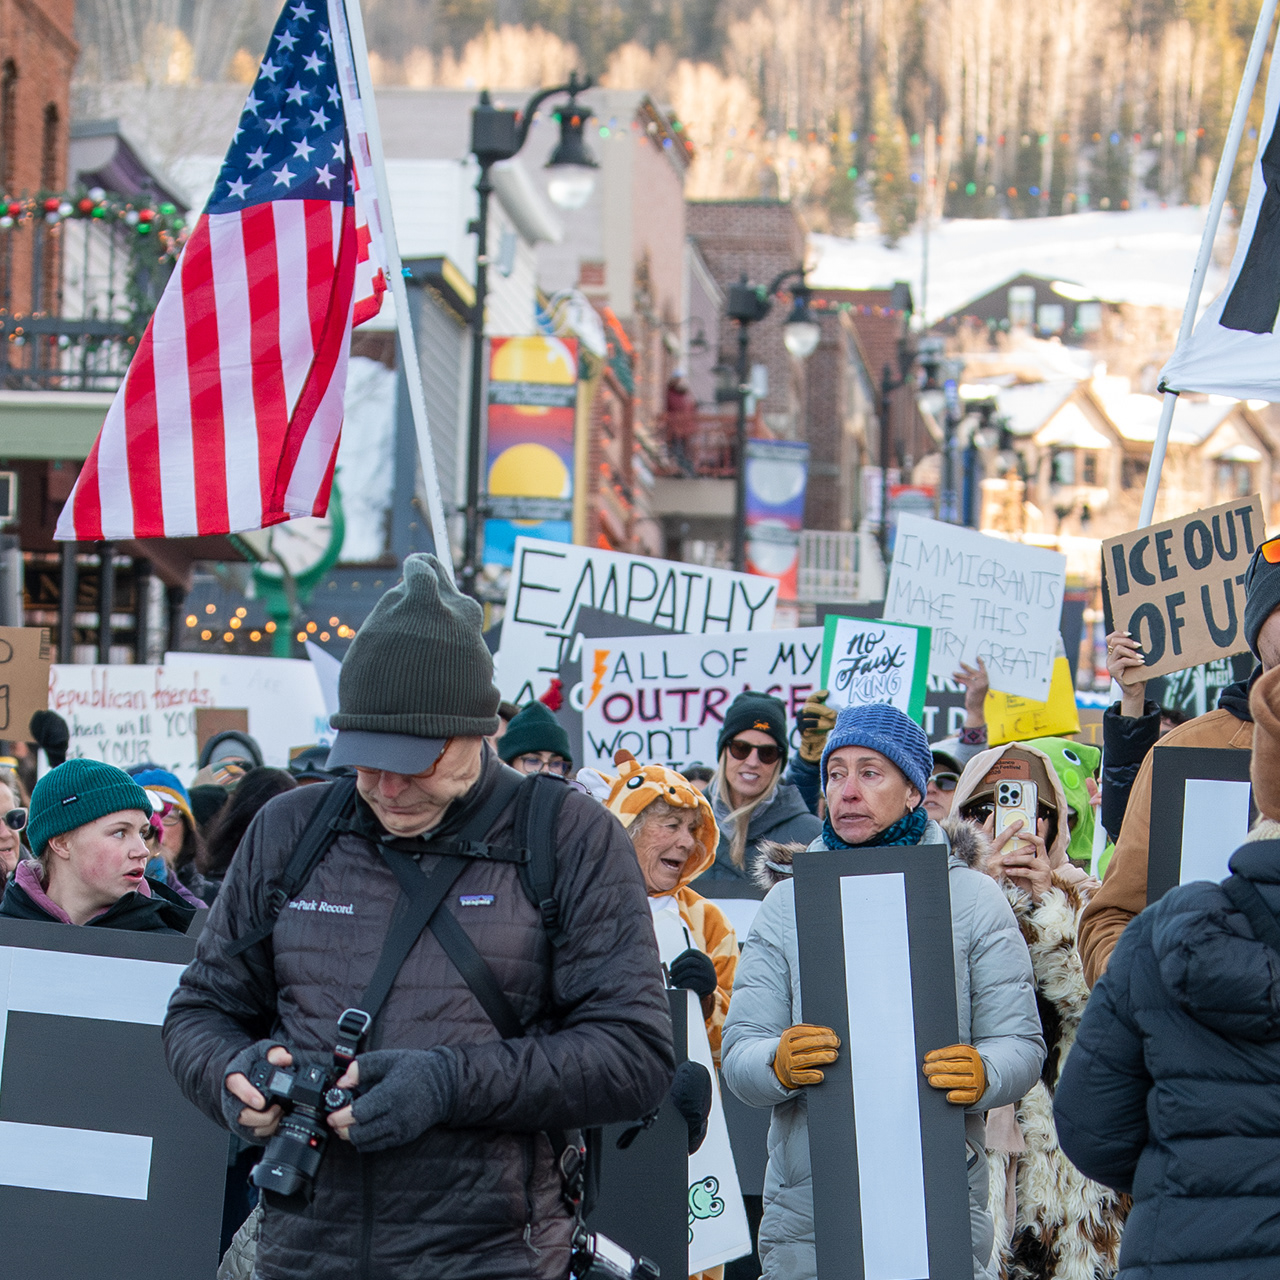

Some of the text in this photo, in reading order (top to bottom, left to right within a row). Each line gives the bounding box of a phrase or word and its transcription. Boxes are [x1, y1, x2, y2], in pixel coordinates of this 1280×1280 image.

[896, 533, 1061, 610] IMMIGRANTS
[1111, 505, 1255, 597] ICE OUT
[513, 547, 776, 634] EMPATHY
[893, 576, 956, 620] MAKE
[970, 598, 1030, 636] THIS
[1127, 591, 1186, 667] OF
[610, 641, 821, 684] ALL OF MY
[976, 639, 1053, 684] GREAT!
[48, 666, 148, 714] Republican
[601, 682, 814, 726] OUTRE
[848, 668, 902, 704] KING
[70, 712, 106, 737] hen
[98, 739, 152, 763] YOUR
[297, 899, 318, 911] Park
[318, 900, 355, 915] Record.
